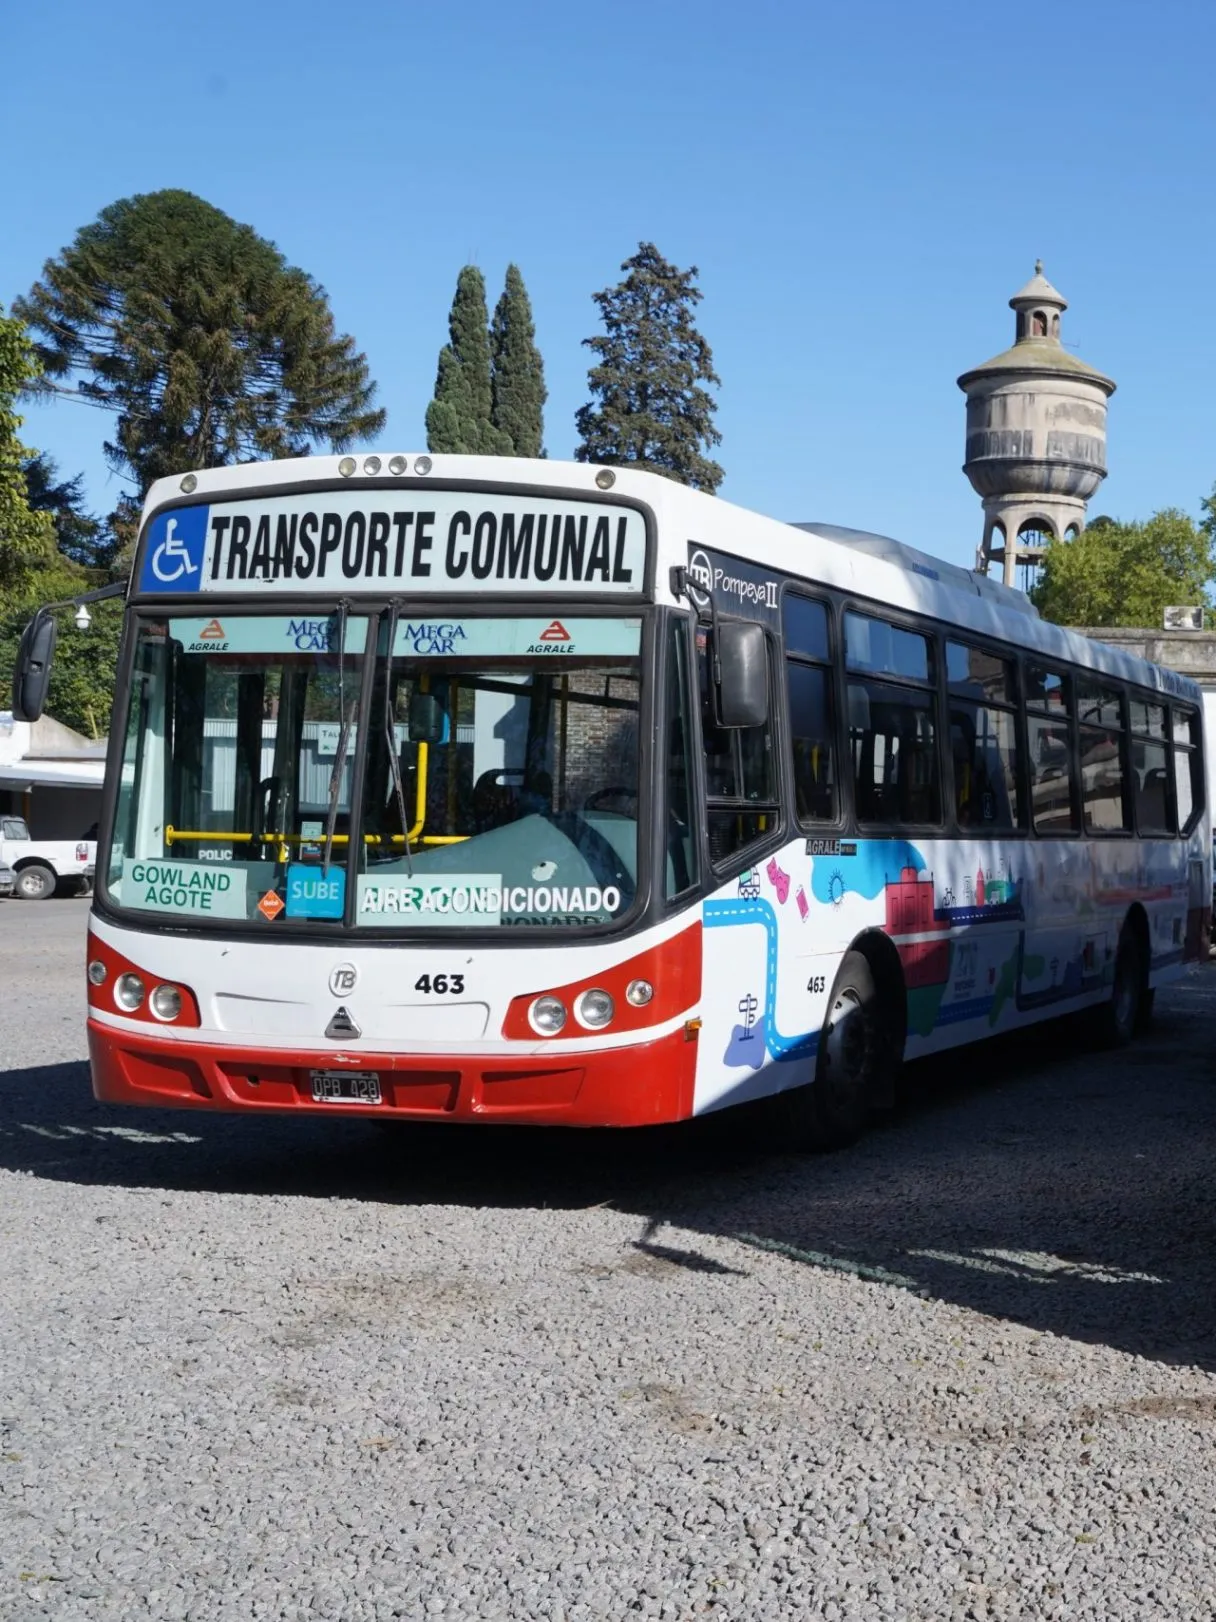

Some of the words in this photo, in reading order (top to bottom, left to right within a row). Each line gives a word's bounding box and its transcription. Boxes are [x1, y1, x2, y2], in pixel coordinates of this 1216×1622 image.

[210, 510, 435, 582] TRANSPORTE
[446, 509, 633, 582] COMUNAL
[714, 567, 766, 605] Pompeya
[403, 624, 468, 640] MEGA
[188, 643, 230, 651] AGRALE
[413, 638, 457, 654] CAR
[526, 645, 576, 654] AGRALE
[806, 840, 840, 854] AGRALE
[132, 864, 231, 892] GOWLAND
[144, 886, 212, 910] AGOTE
[291, 881, 340, 900] SUBE
[361, 887, 414, 913] AIRE
[420, 886, 621, 913] ACONDICIONADO
[414, 973, 465, 994] 463
[807, 976, 826, 993] 463
[351, 1080, 378, 1098] 428
